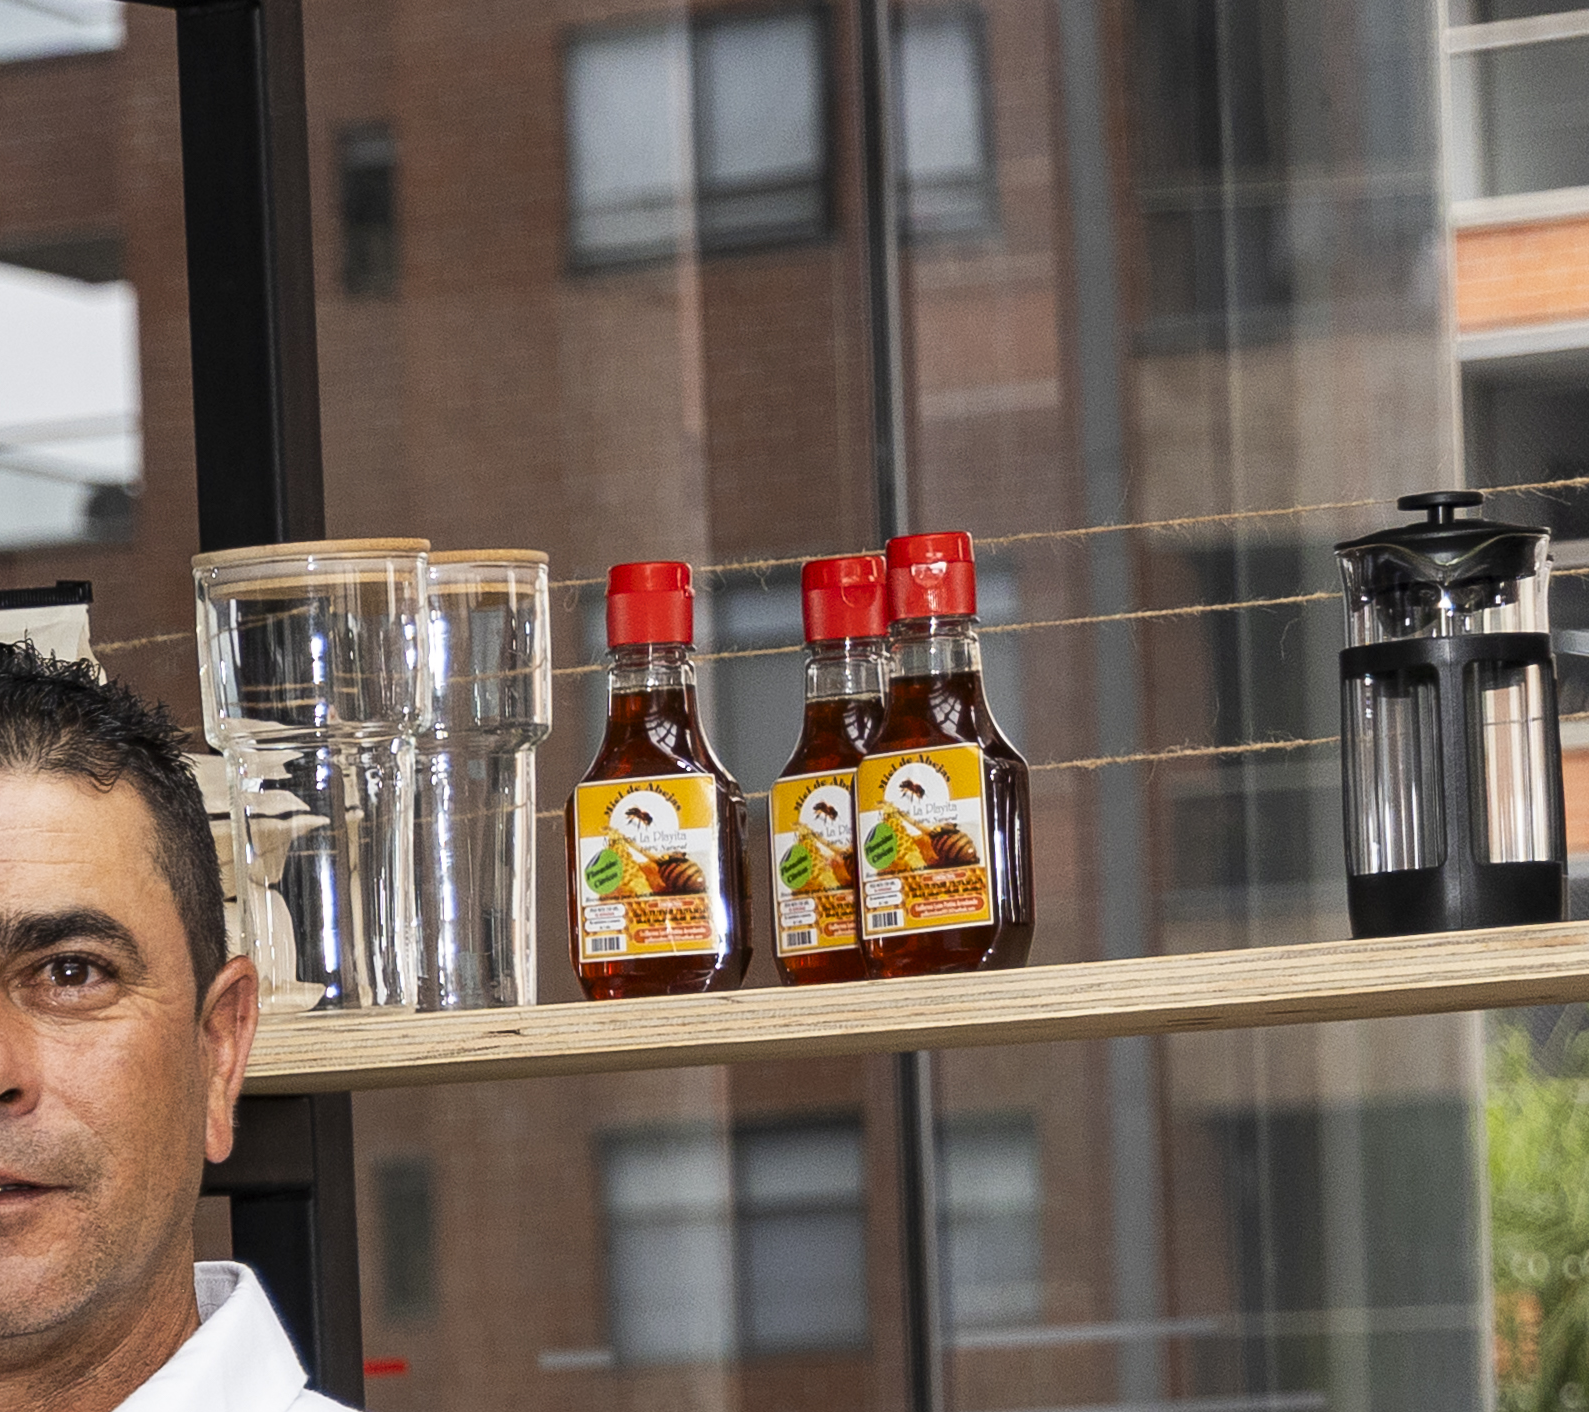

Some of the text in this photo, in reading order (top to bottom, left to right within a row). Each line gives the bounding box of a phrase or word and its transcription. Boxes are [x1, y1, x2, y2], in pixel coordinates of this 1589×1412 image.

[916, 754, 951, 783] Abejas
[604, 782, 681, 817] Miel de Abejas
